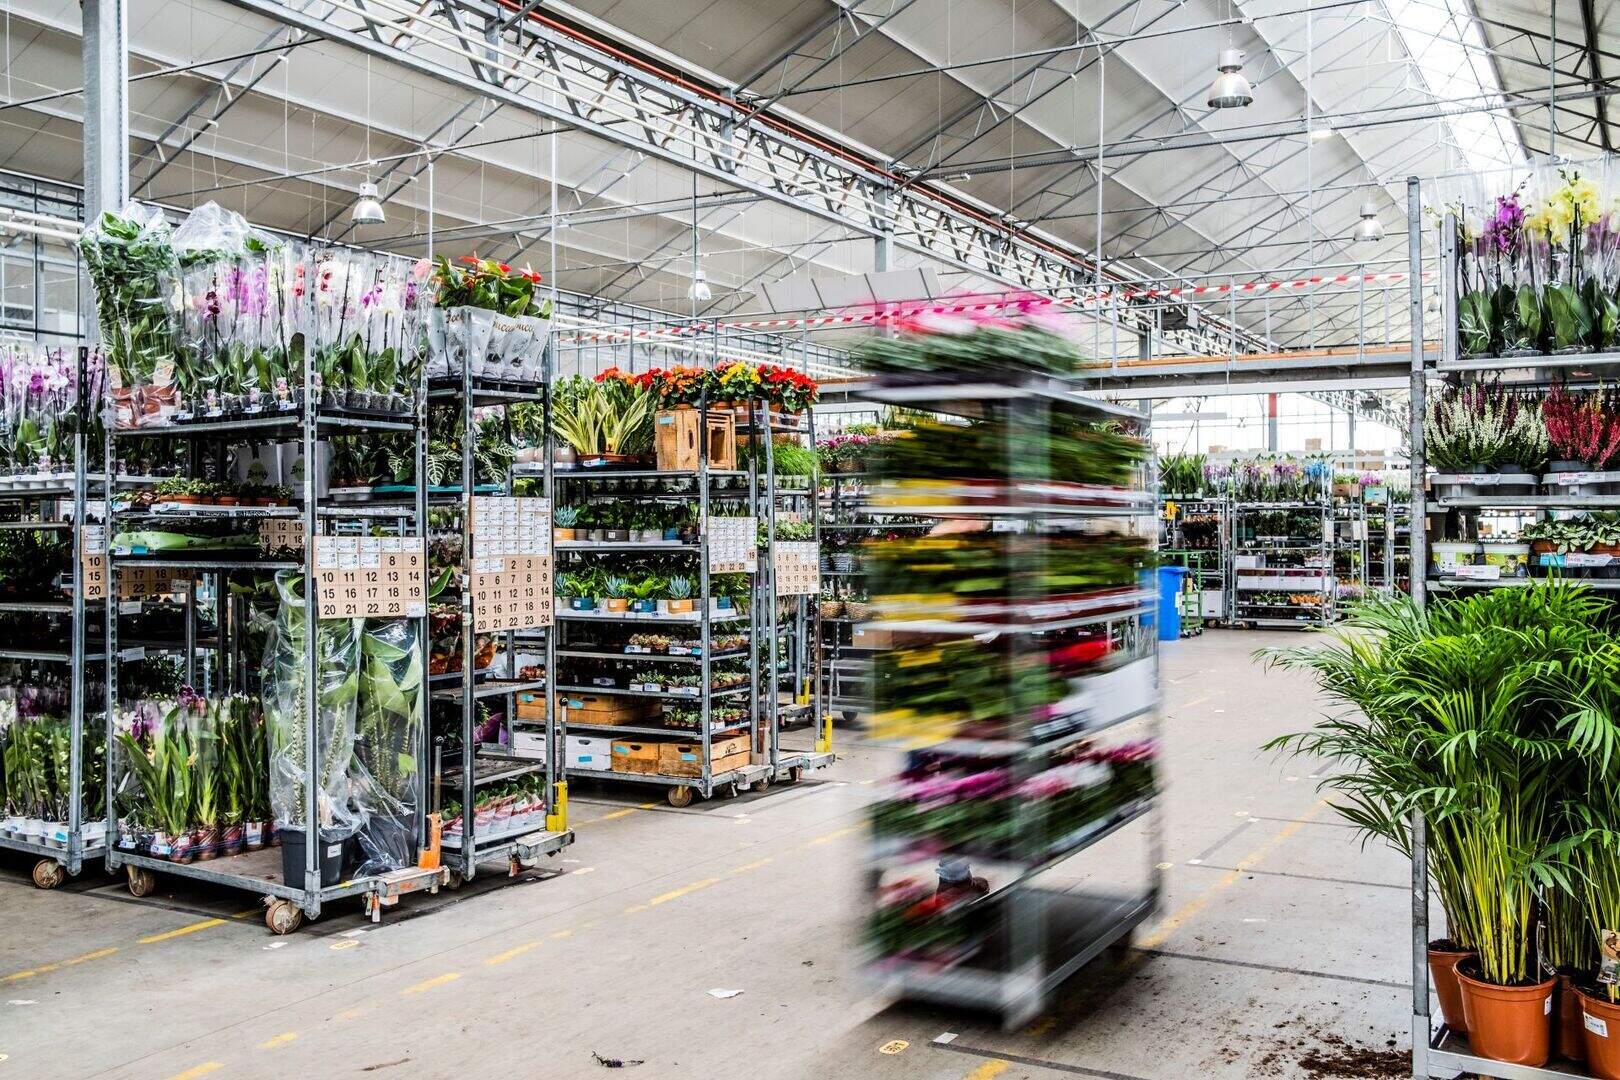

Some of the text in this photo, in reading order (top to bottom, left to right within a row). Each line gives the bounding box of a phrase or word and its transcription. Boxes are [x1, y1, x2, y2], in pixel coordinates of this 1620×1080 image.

[277, 522, 286, 530] 12
[261, 535, 302, 543] 16 17 18
[89, 557, 100, 566] 10
[389, 556, 395, 566] 8
[410, 556, 417, 565] 9
[511, 560, 516, 569] 2
[527, 560, 532, 568] 3
[543, 559, 547, 567] 4
[89, 571, 100, 581] 15
[133, 570, 144, 578] 17
[155, 569, 167, 578] 18
[322, 571, 420, 582] 10 11 12 13 14
[480, 573, 547, 586] 5 6 7 8 9
[89, 586, 101, 595] 20
[133, 584, 145, 593] 22
[155, 583, 167, 592] 23
[323, 587, 420, 599] 15 16 17 18 19
[478, 587, 549, 601] 10 11 12 13 14
[324, 605, 336, 615] 20
[346, 604, 357, 614] 21
[367, 604, 379, 613] 22
[388, 603, 400, 613] 23
[478, 601, 549, 615] 15 16 17 18 19
[478, 615, 549, 629] 20 21 22 23 24
